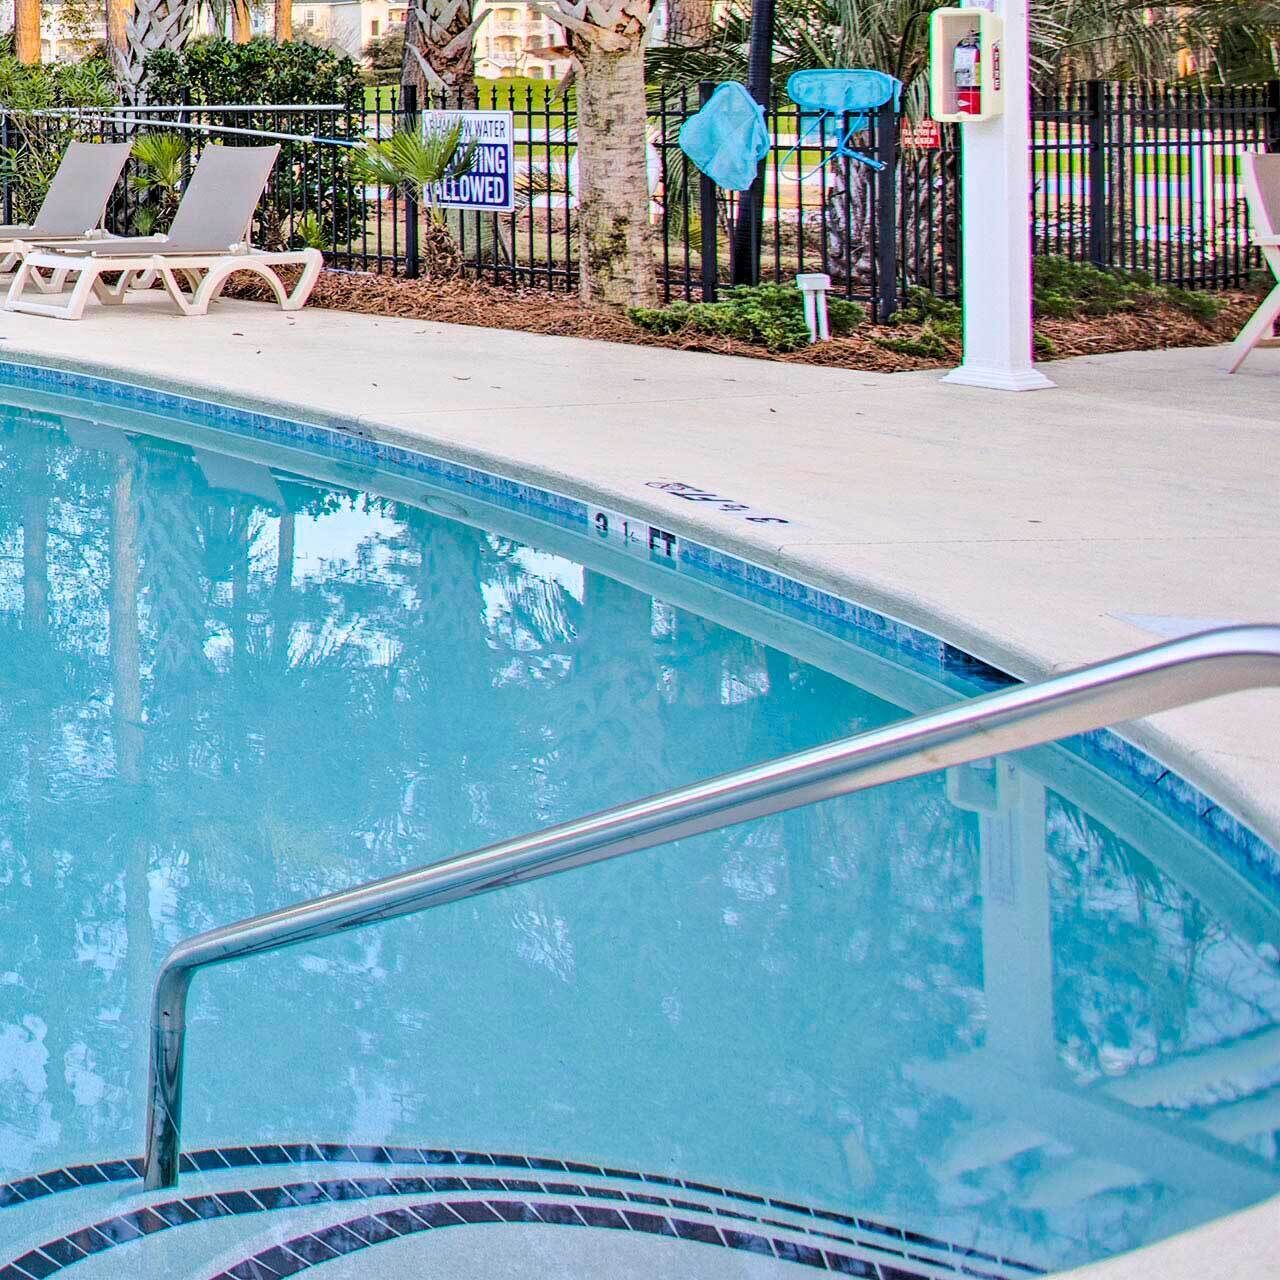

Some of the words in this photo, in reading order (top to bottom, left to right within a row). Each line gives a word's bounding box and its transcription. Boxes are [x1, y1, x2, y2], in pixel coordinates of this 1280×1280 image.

[474, 120, 506, 139] WATER
[433, 176, 505, 204] ALLOWED
[648, 526, 677, 557] FT
